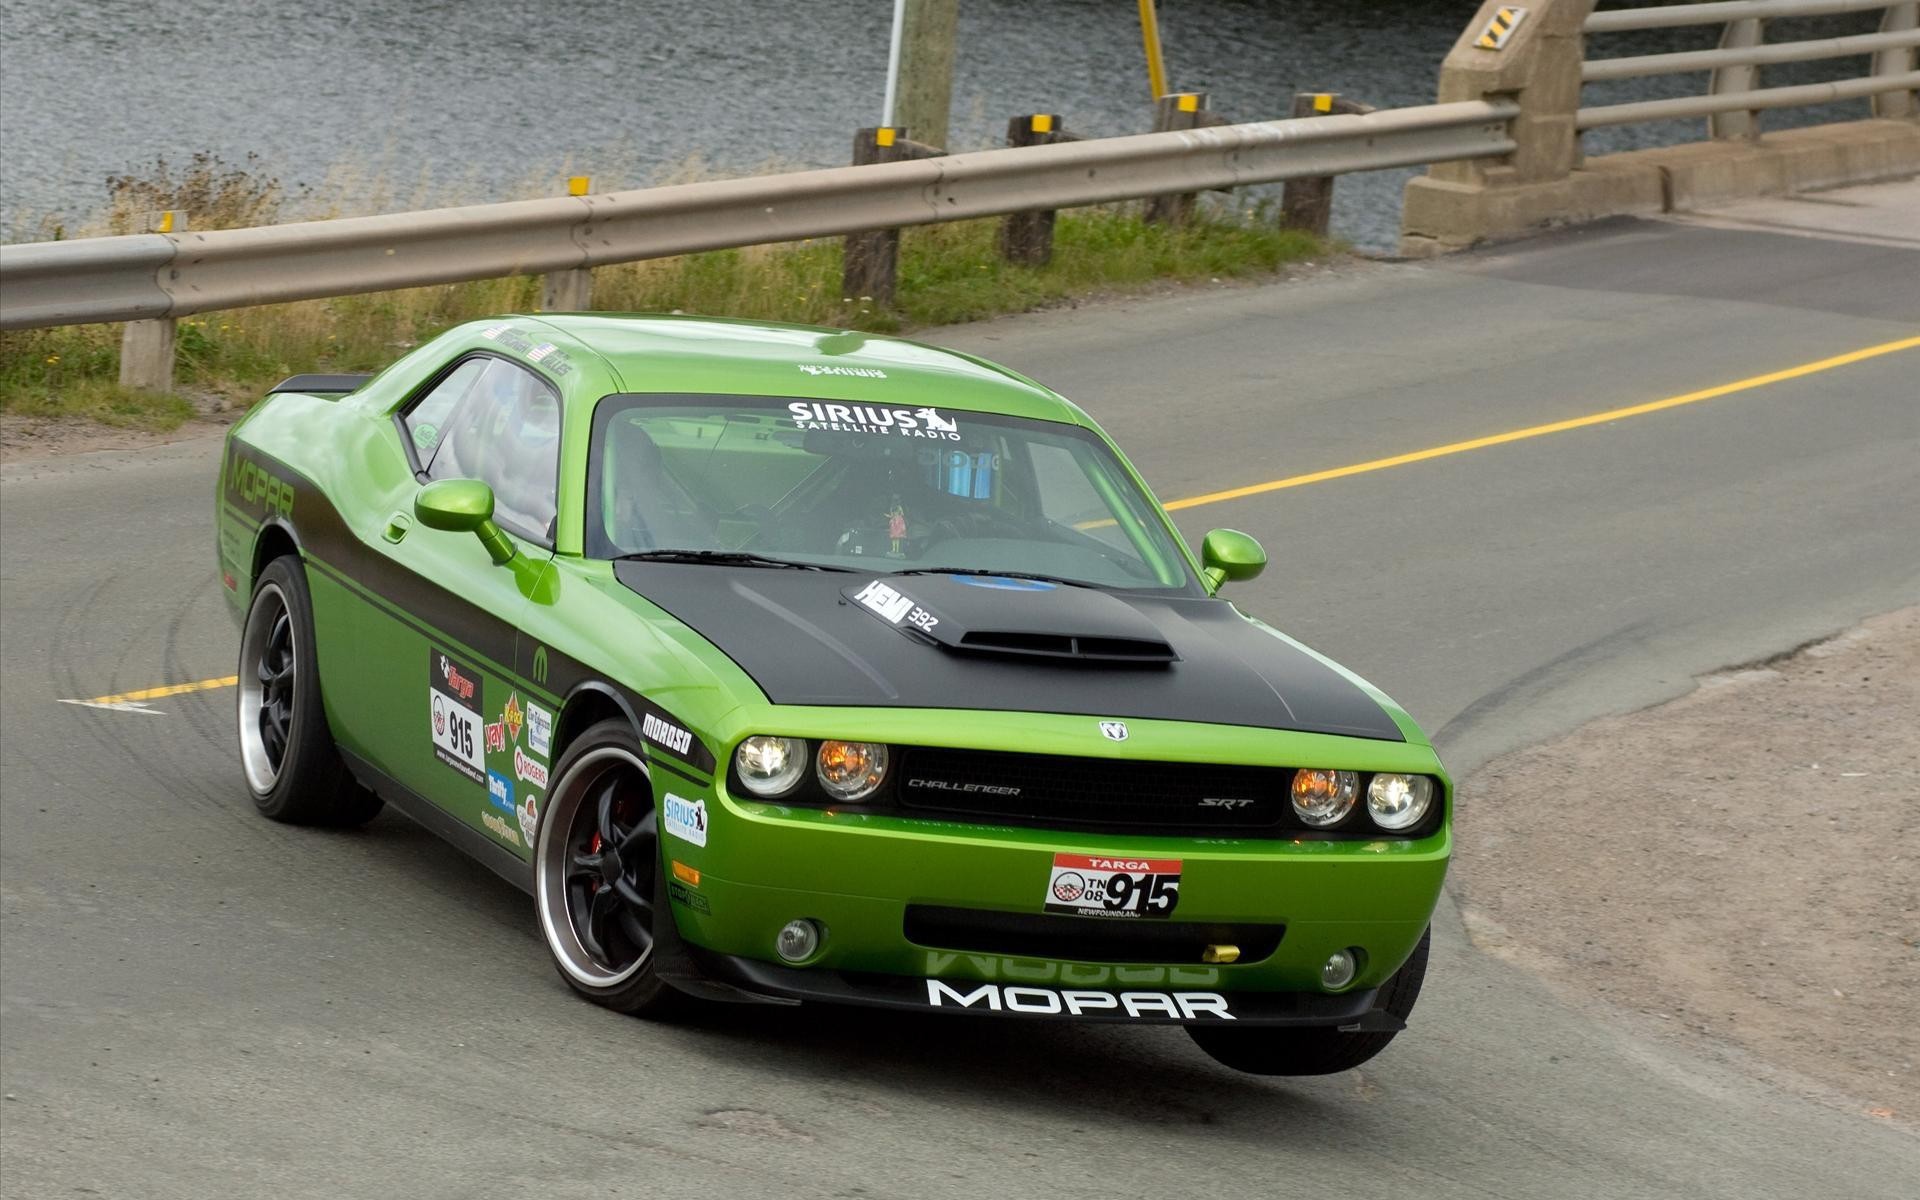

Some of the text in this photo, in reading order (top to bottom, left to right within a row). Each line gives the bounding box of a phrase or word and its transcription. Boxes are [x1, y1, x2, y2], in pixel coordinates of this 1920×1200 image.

[788, 402, 918, 429] SIRIUS
[796, 420, 961, 441] SATELLITE RADIO
[231, 452, 294, 519] MOPAR
[854, 579, 939, 632] HEMI 392
[450, 710, 473, 759] 915
[643, 712, 692, 755] MOROSO
[524, 760, 546, 784] ROGERS
[908, 778, 1021, 797] CHALLENGER
[666, 799, 695, 827] SIRIUS
[1198, 797, 1254, 810] SRT
[1089, 858, 1150, 870] TARGA
[1084, 890, 1103, 902] 08
[1088, 878, 1107, 889] TN
[1103, 873, 1181, 915] 915
[926, 979, 1237, 1020] MOPAR
